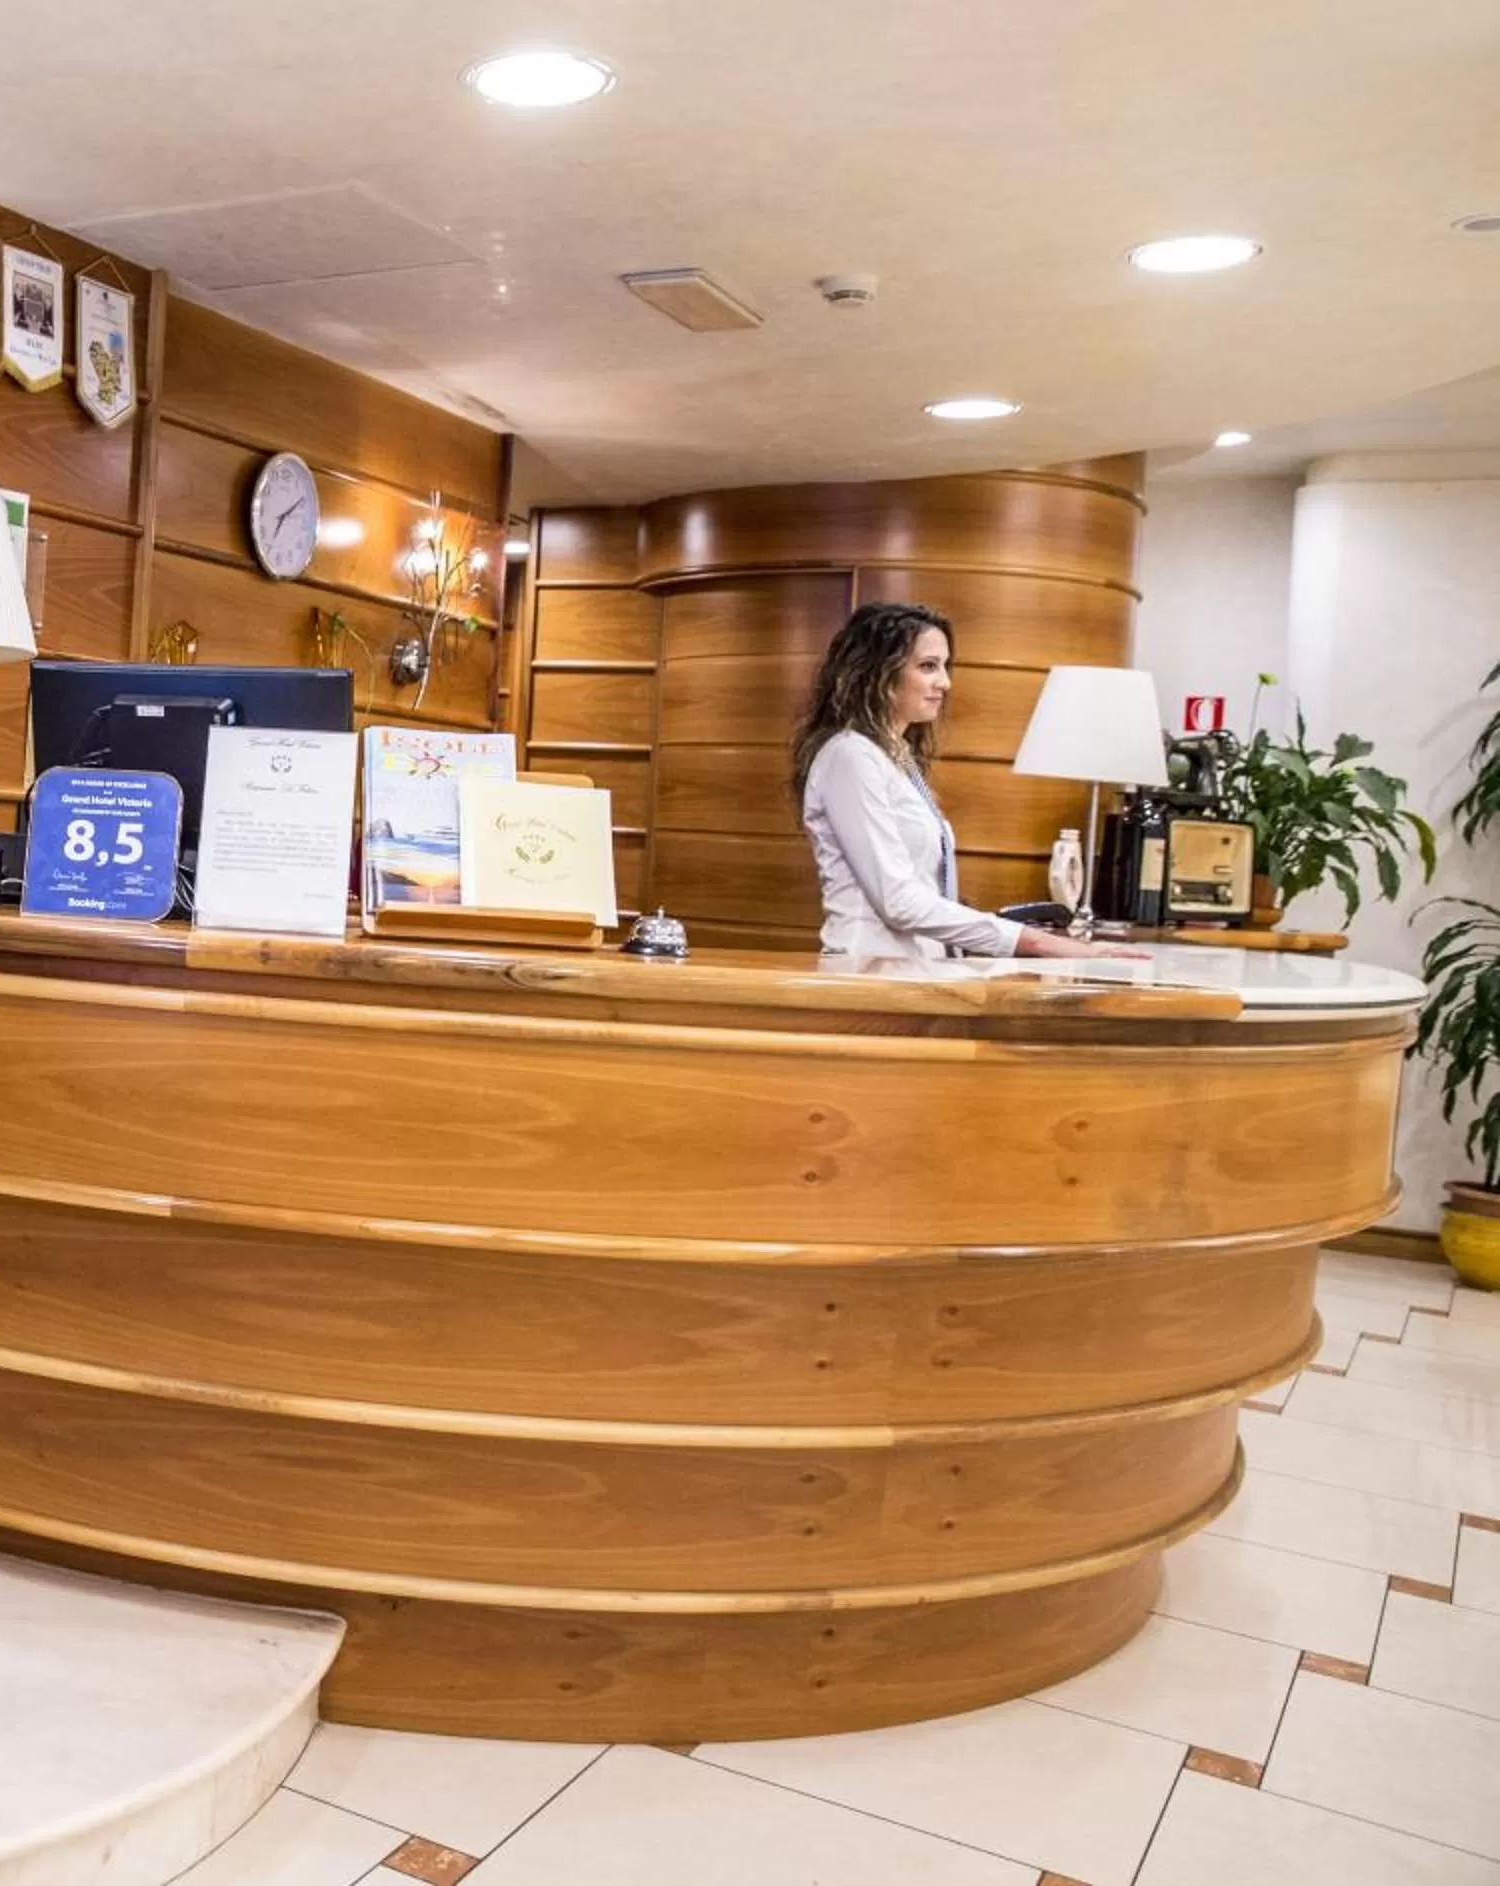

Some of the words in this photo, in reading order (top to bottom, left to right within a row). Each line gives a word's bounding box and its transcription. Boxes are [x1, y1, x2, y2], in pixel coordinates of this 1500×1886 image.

[61, 794, 90, 805] Grand
[91, 795, 117, 806] Hotel
[117, 796, 153, 809] Victoria
[63, 819, 145, 867] 8,5
